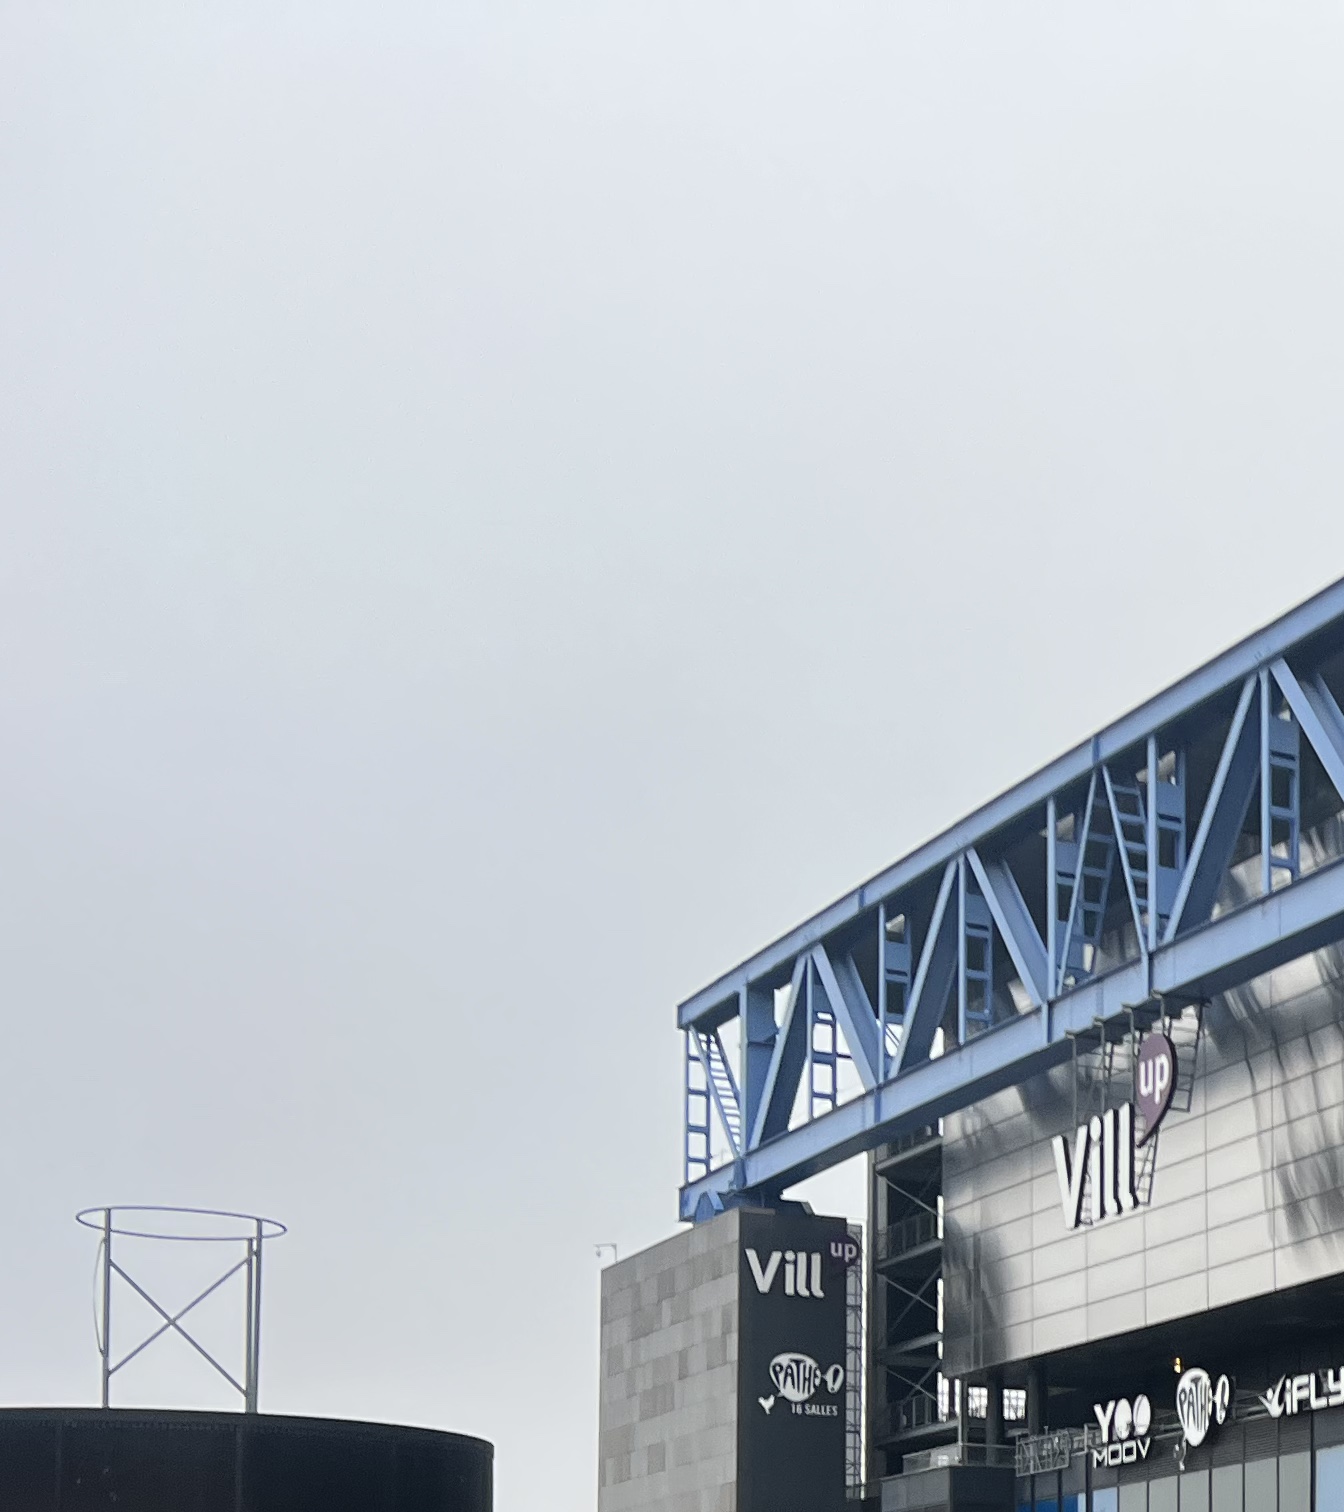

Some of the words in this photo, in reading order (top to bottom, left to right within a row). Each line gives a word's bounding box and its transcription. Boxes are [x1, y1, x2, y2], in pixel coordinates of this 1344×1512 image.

[1139, 1053, 1170, 1105] up
[1052, 1102, 1139, 1231] Vill
[745, 1248, 825, 1298] Vill
[830, 1242, 858, 1263] up
[804, 1404, 838, 1416] SALLES
[1093, 1437, 1150, 1469] MOOV
